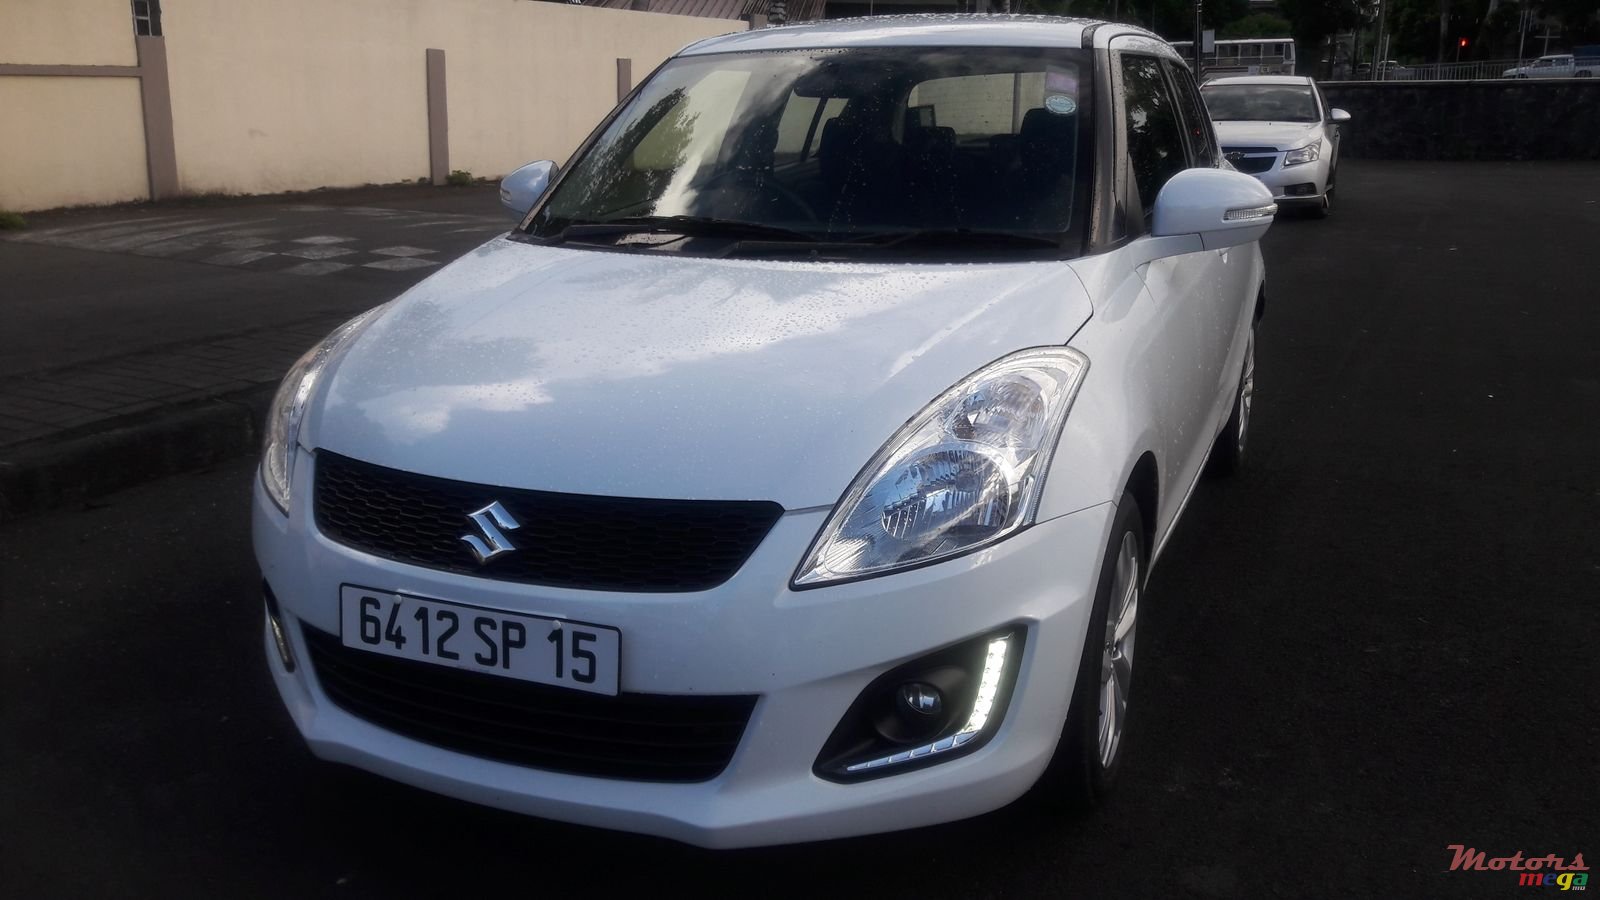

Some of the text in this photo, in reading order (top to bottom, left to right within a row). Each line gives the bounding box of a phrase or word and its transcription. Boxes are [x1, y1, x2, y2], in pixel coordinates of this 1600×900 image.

[360, 596, 597, 684] 6412 SP 15
